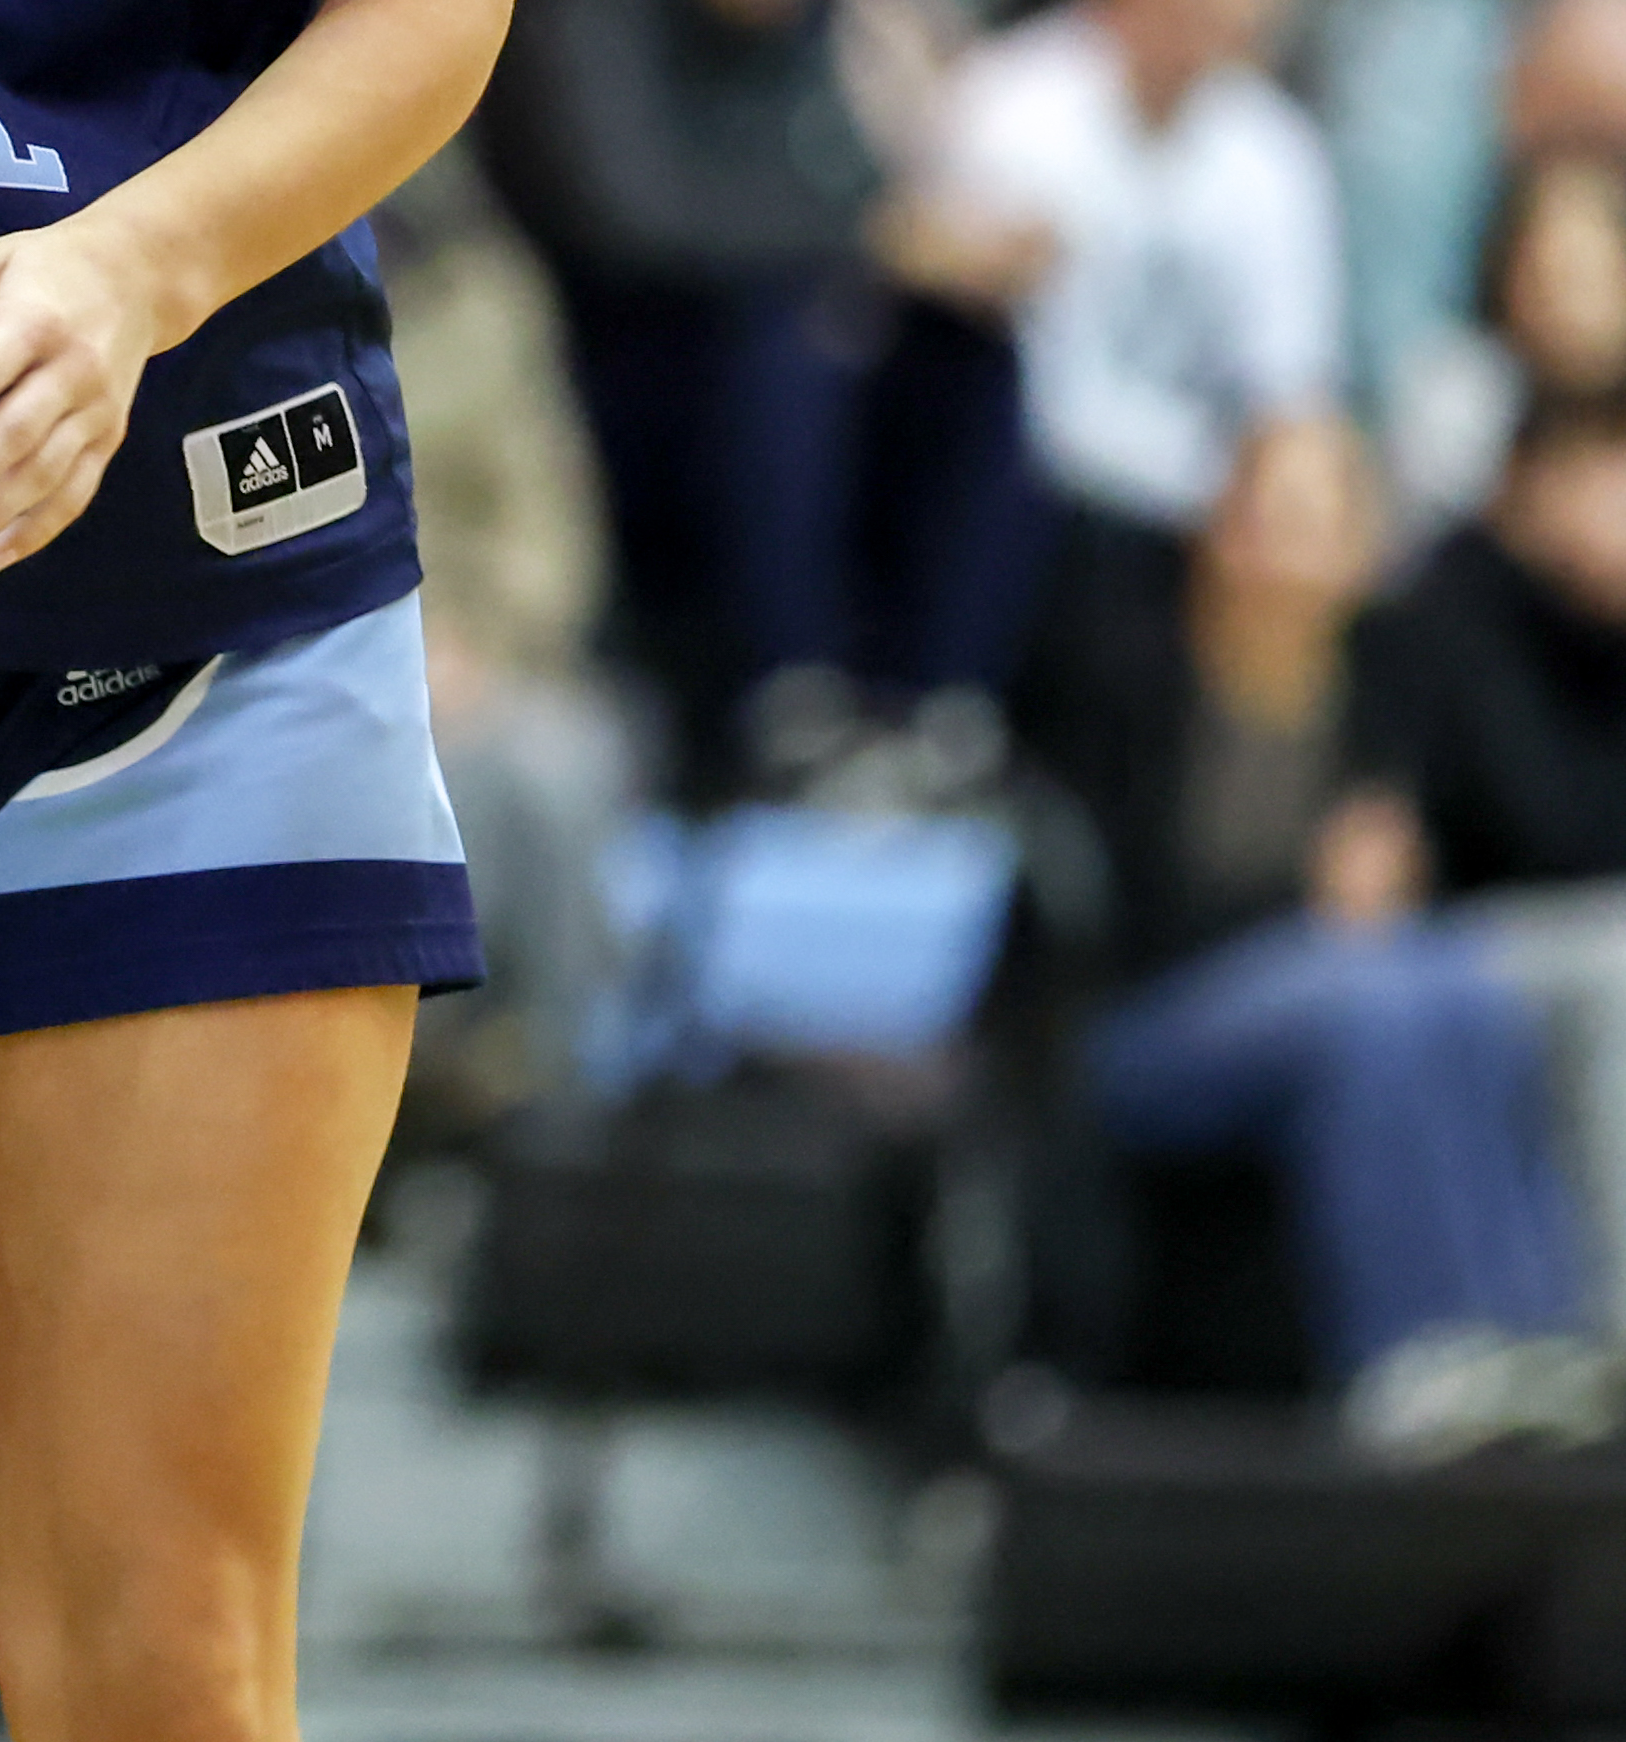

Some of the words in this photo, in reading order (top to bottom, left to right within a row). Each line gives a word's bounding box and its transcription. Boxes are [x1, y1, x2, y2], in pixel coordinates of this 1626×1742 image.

[312, 422, 334, 453] M
[238, 463, 290, 495] adidas
[57, 664, 161, 706] adidas
